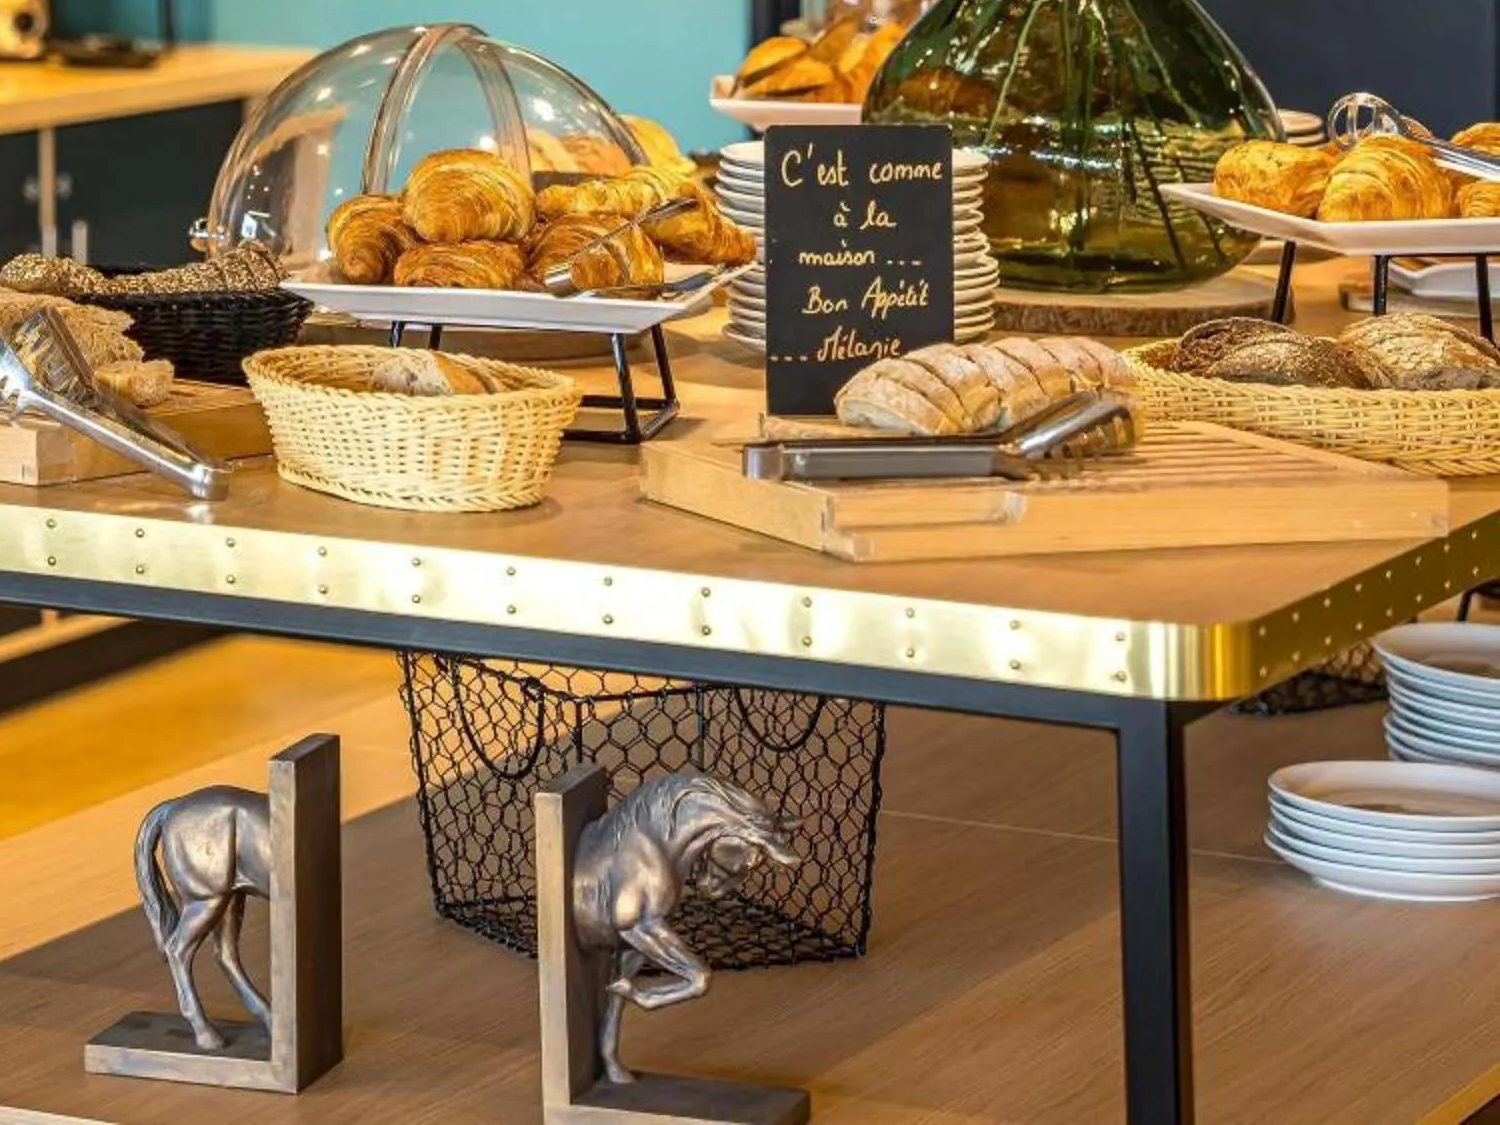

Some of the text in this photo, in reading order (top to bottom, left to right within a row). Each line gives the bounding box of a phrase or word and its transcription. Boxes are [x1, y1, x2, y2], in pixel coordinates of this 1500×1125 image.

[781, 142, 942, 187] C'est comme
[833, 200, 897, 230] à la
[802, 276, 929, 320] Bon Appétit
